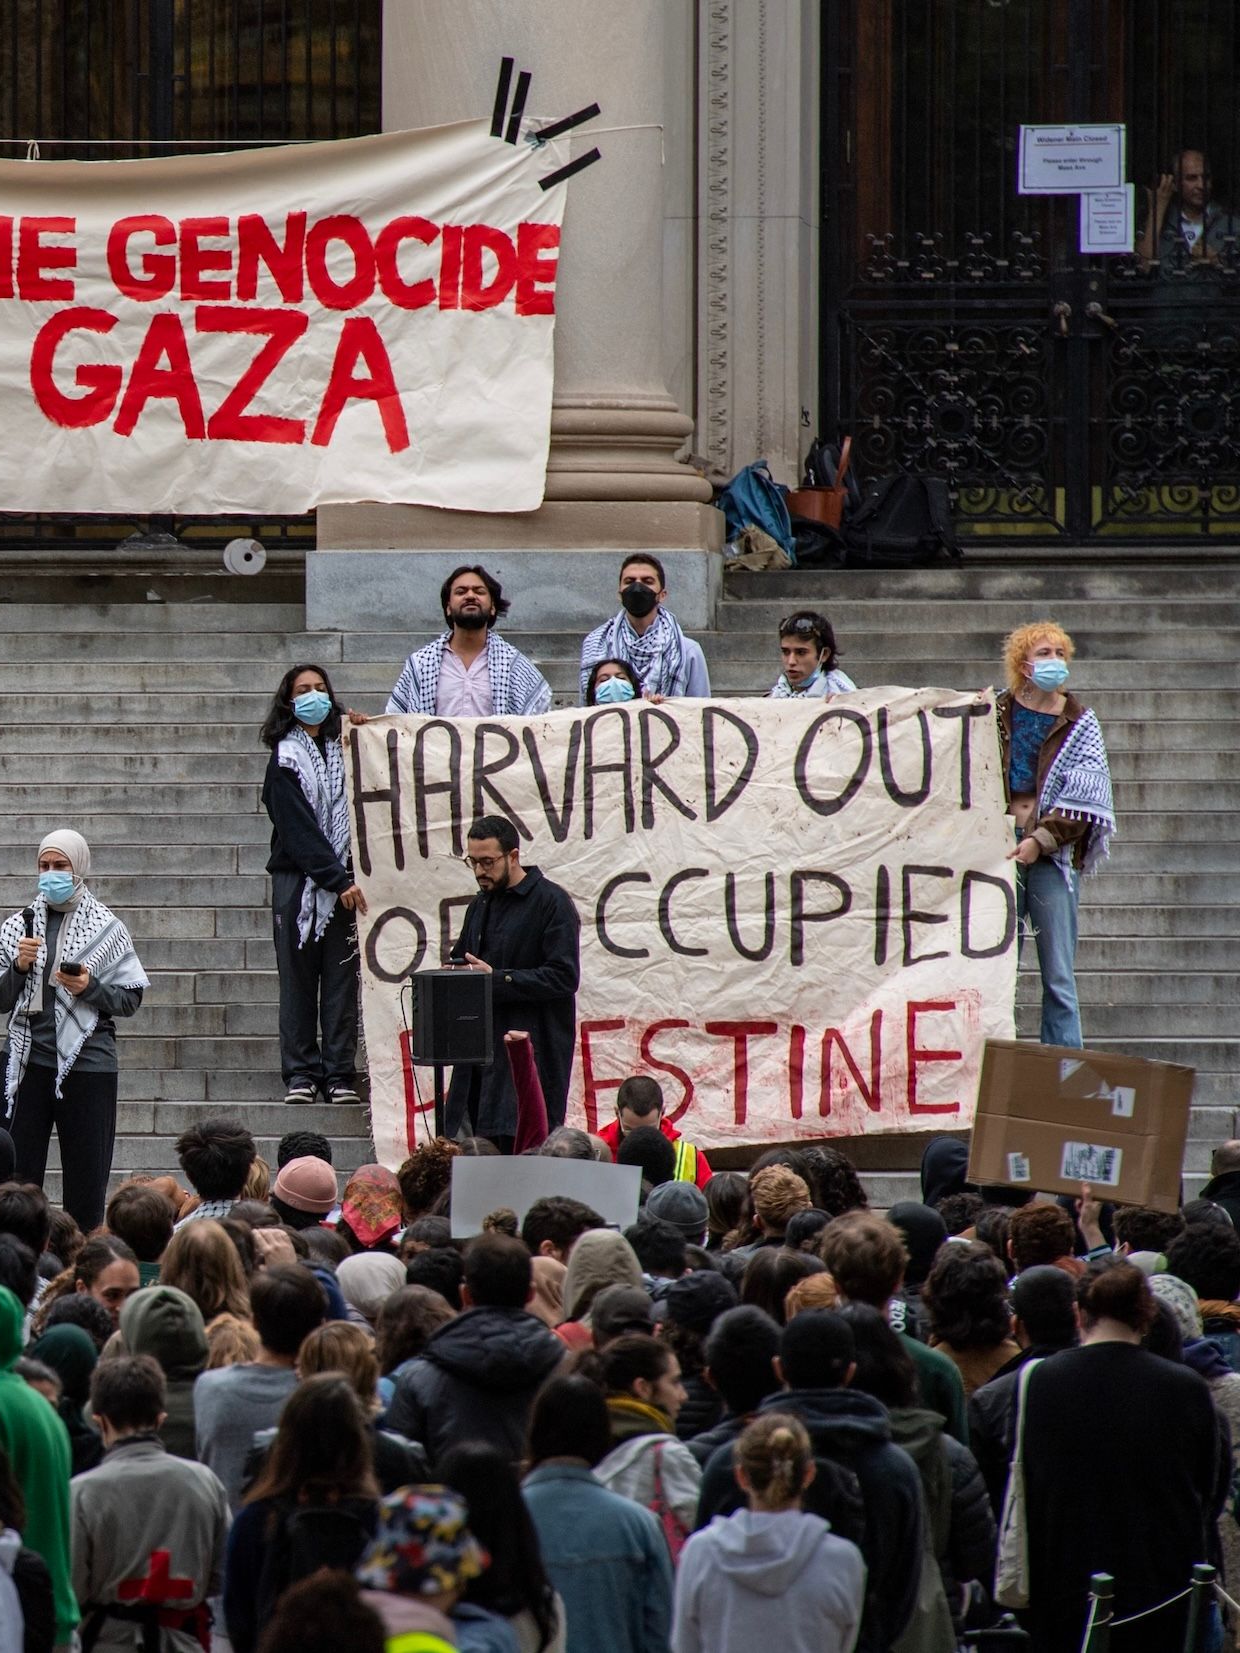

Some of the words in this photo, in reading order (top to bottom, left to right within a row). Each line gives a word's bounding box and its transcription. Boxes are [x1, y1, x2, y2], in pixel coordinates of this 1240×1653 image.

[106, 210, 562, 317] GENOCIDE
[30, 304, 412, 454] GAZA
[345, 704, 759, 878] HARVARD
[793, 702, 992, 817] OUT
[595, 864, 1017, 969] CCUPIED
